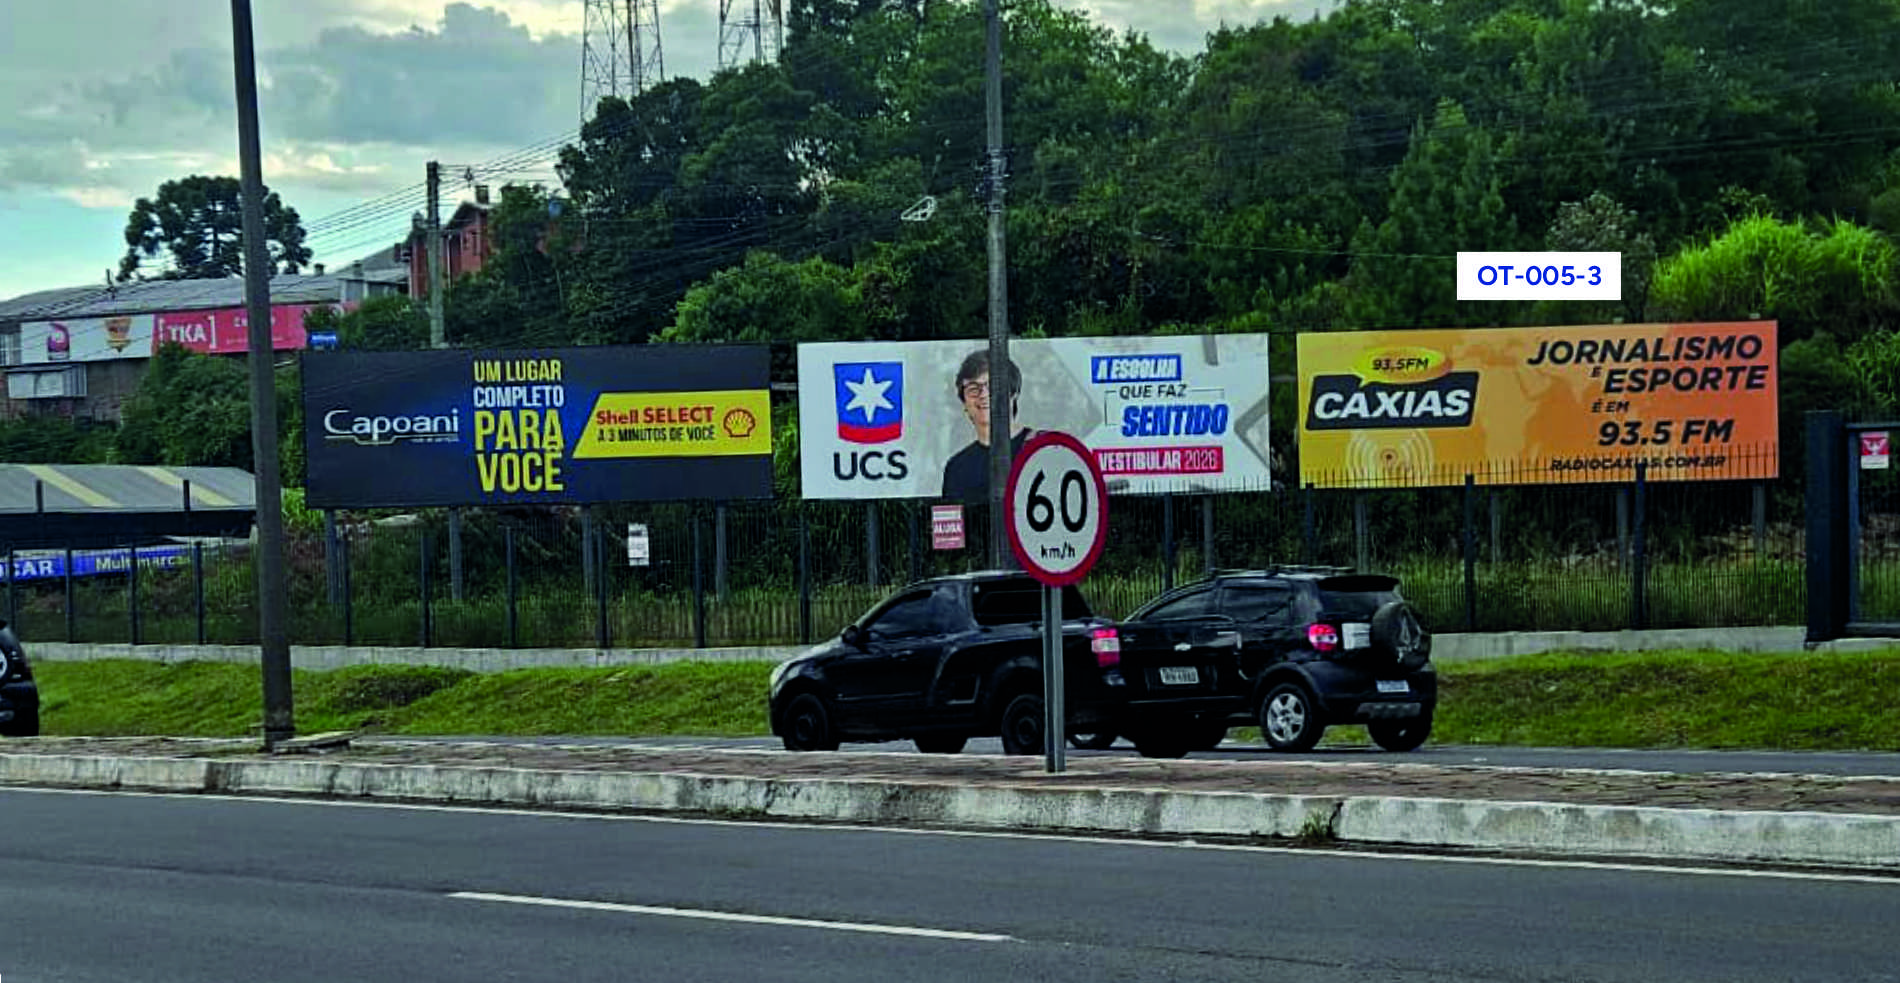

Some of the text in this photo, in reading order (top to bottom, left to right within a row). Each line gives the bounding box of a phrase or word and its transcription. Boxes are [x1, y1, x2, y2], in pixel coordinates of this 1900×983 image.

[1527, 334, 1763, 366] JORNALISMO
[474, 359, 562, 382] UM LUGAR
[1097, 357, 1178, 380] A ESCOLHA
[1591, 366, 1602, 378] E
[1604, 365, 1769, 394] ESPORTE
[473, 385, 564, 408] COMPLETO
[1119, 383, 1188, 400] QUE FAZ
[596, 406, 715, 424] Shell SELECT
[1313, 389, 1472, 420] CAXIAS
[1605, 400, 1630, 413] EM
[324, 408, 459, 445] Capoani
[474, 409, 564, 450] PARA
[1121, 403, 1229, 438] SENTIDO
[1598, 419, 1735, 446] 93.5 FM
[618, 426, 667, 442] MINUTOS
[669, 426, 684, 441] DE
[476, 441, 564, 492] VOCÊ
[833, 450, 908, 481] UCS
[1099, 450, 1182, 472] VESTIBULAR
[1026, 469, 1089, 533] 60
[1040, 542, 1076, 559] km/h
